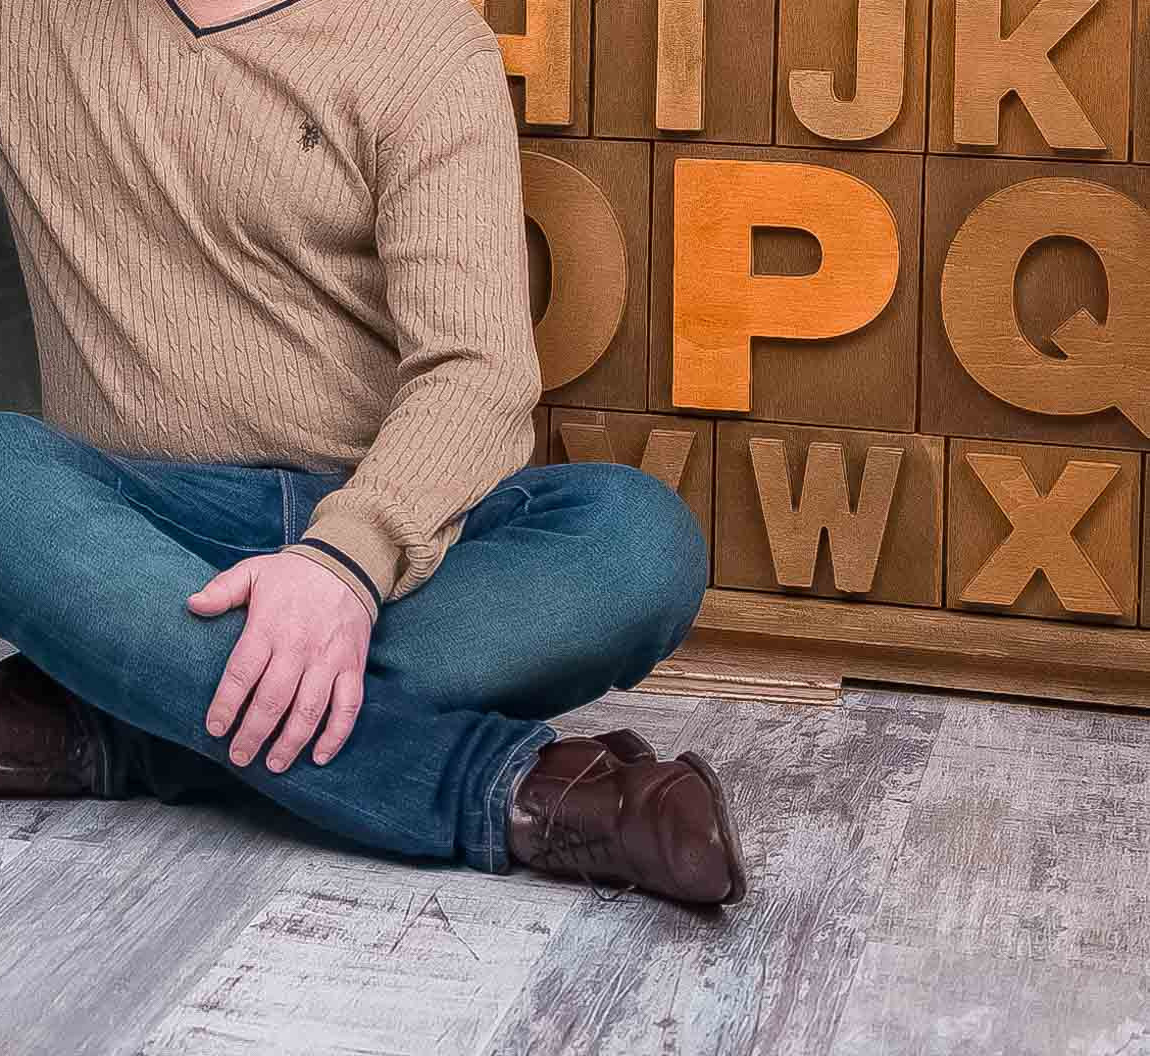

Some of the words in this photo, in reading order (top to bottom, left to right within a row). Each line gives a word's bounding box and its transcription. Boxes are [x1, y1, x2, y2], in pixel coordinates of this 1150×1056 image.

[672, 158, 900, 412] P
[940, 177, 1150, 440] Q
[749, 438, 905, 594] W
[959, 452, 1123, 616] X
